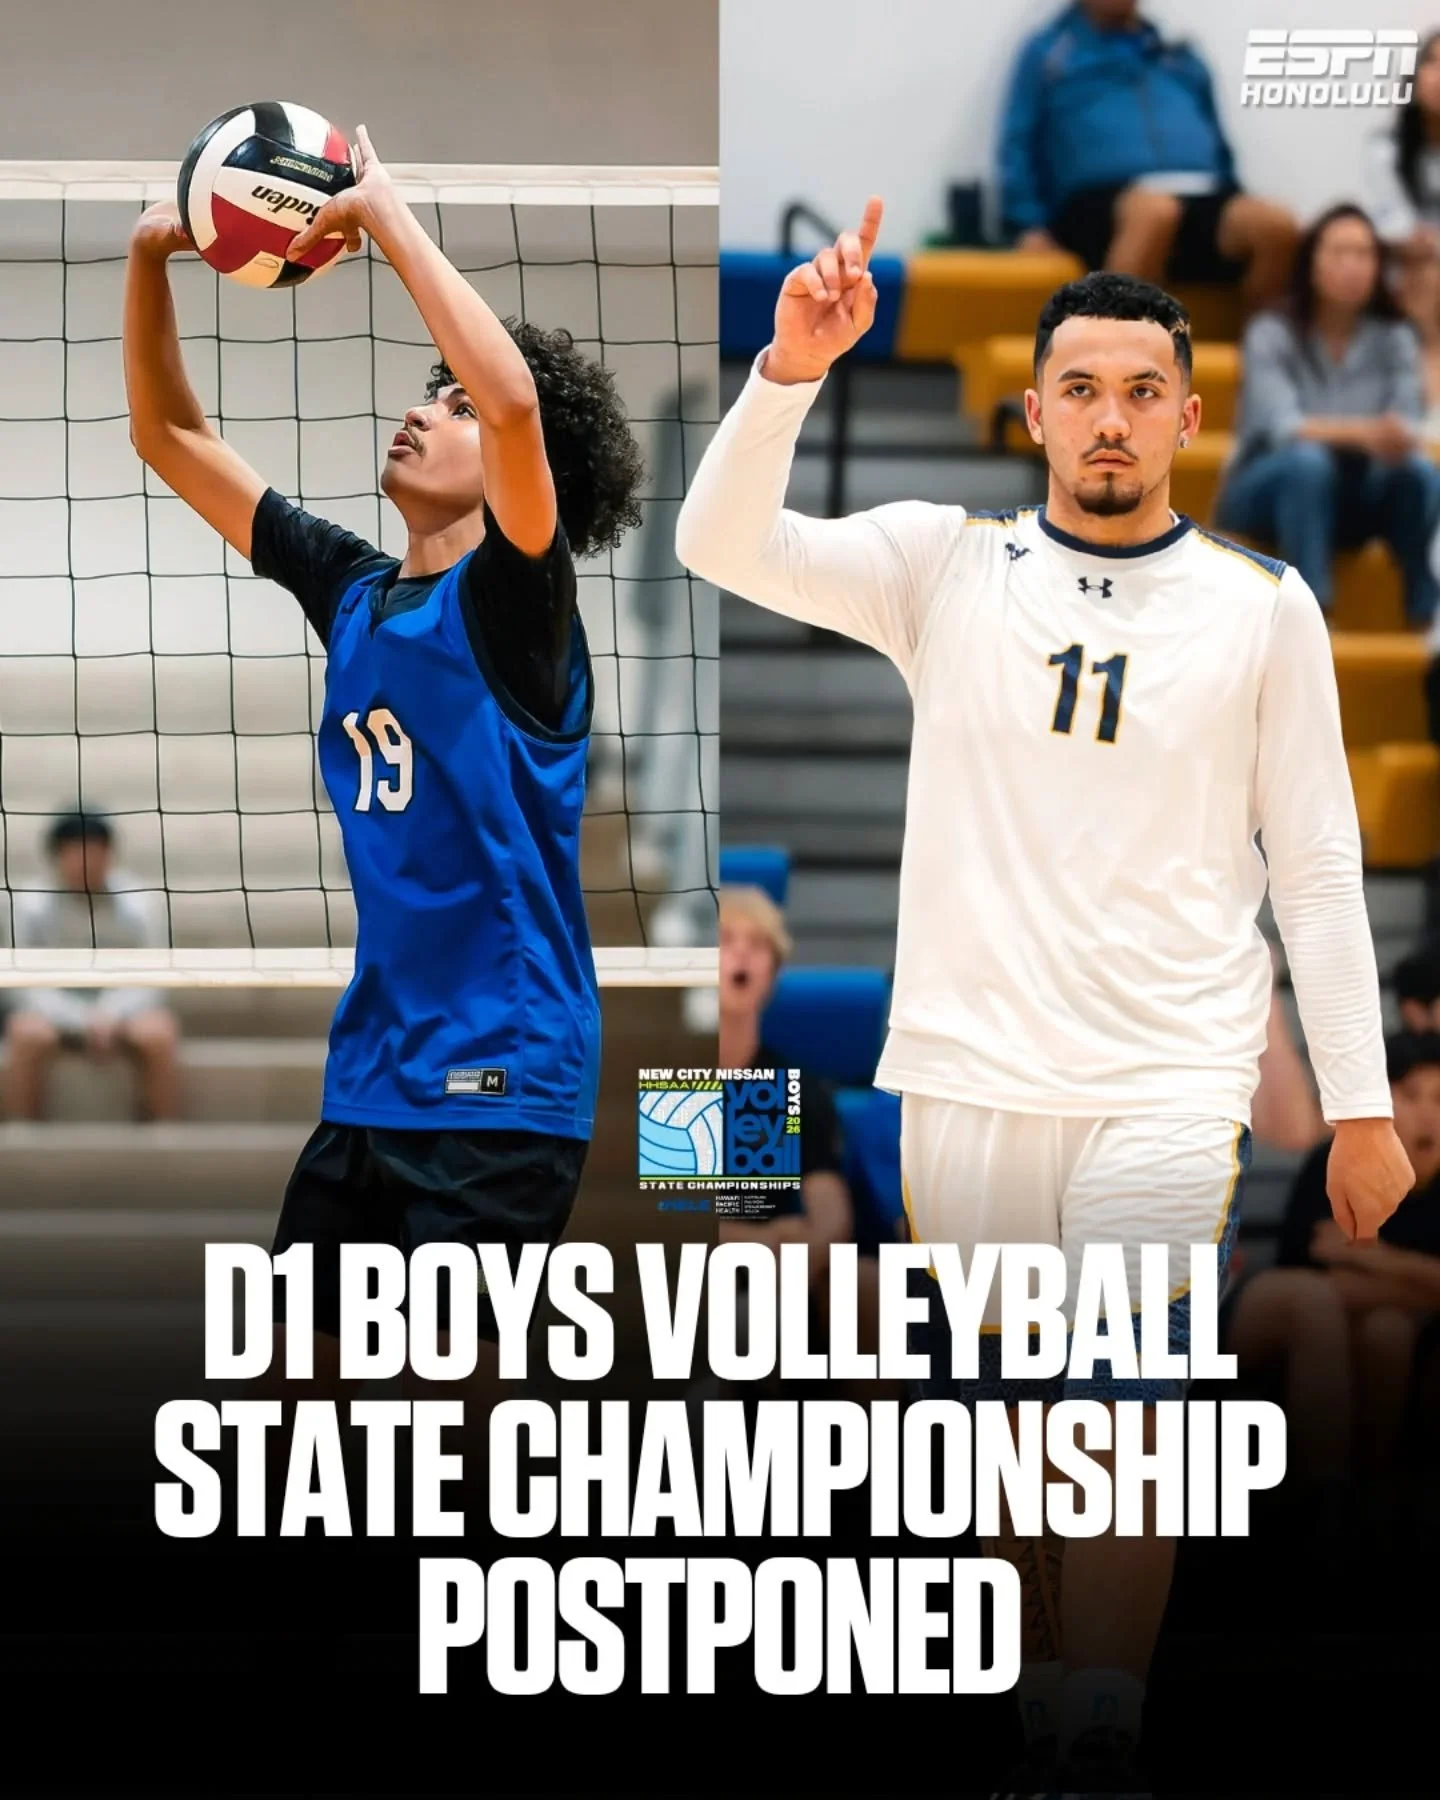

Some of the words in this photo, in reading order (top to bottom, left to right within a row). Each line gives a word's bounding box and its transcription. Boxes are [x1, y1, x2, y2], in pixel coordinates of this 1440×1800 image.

[1046, 642, 1129, 744] 11
[342, 708, 413, 812] 19
[486, 1075, 499, 1088] M
